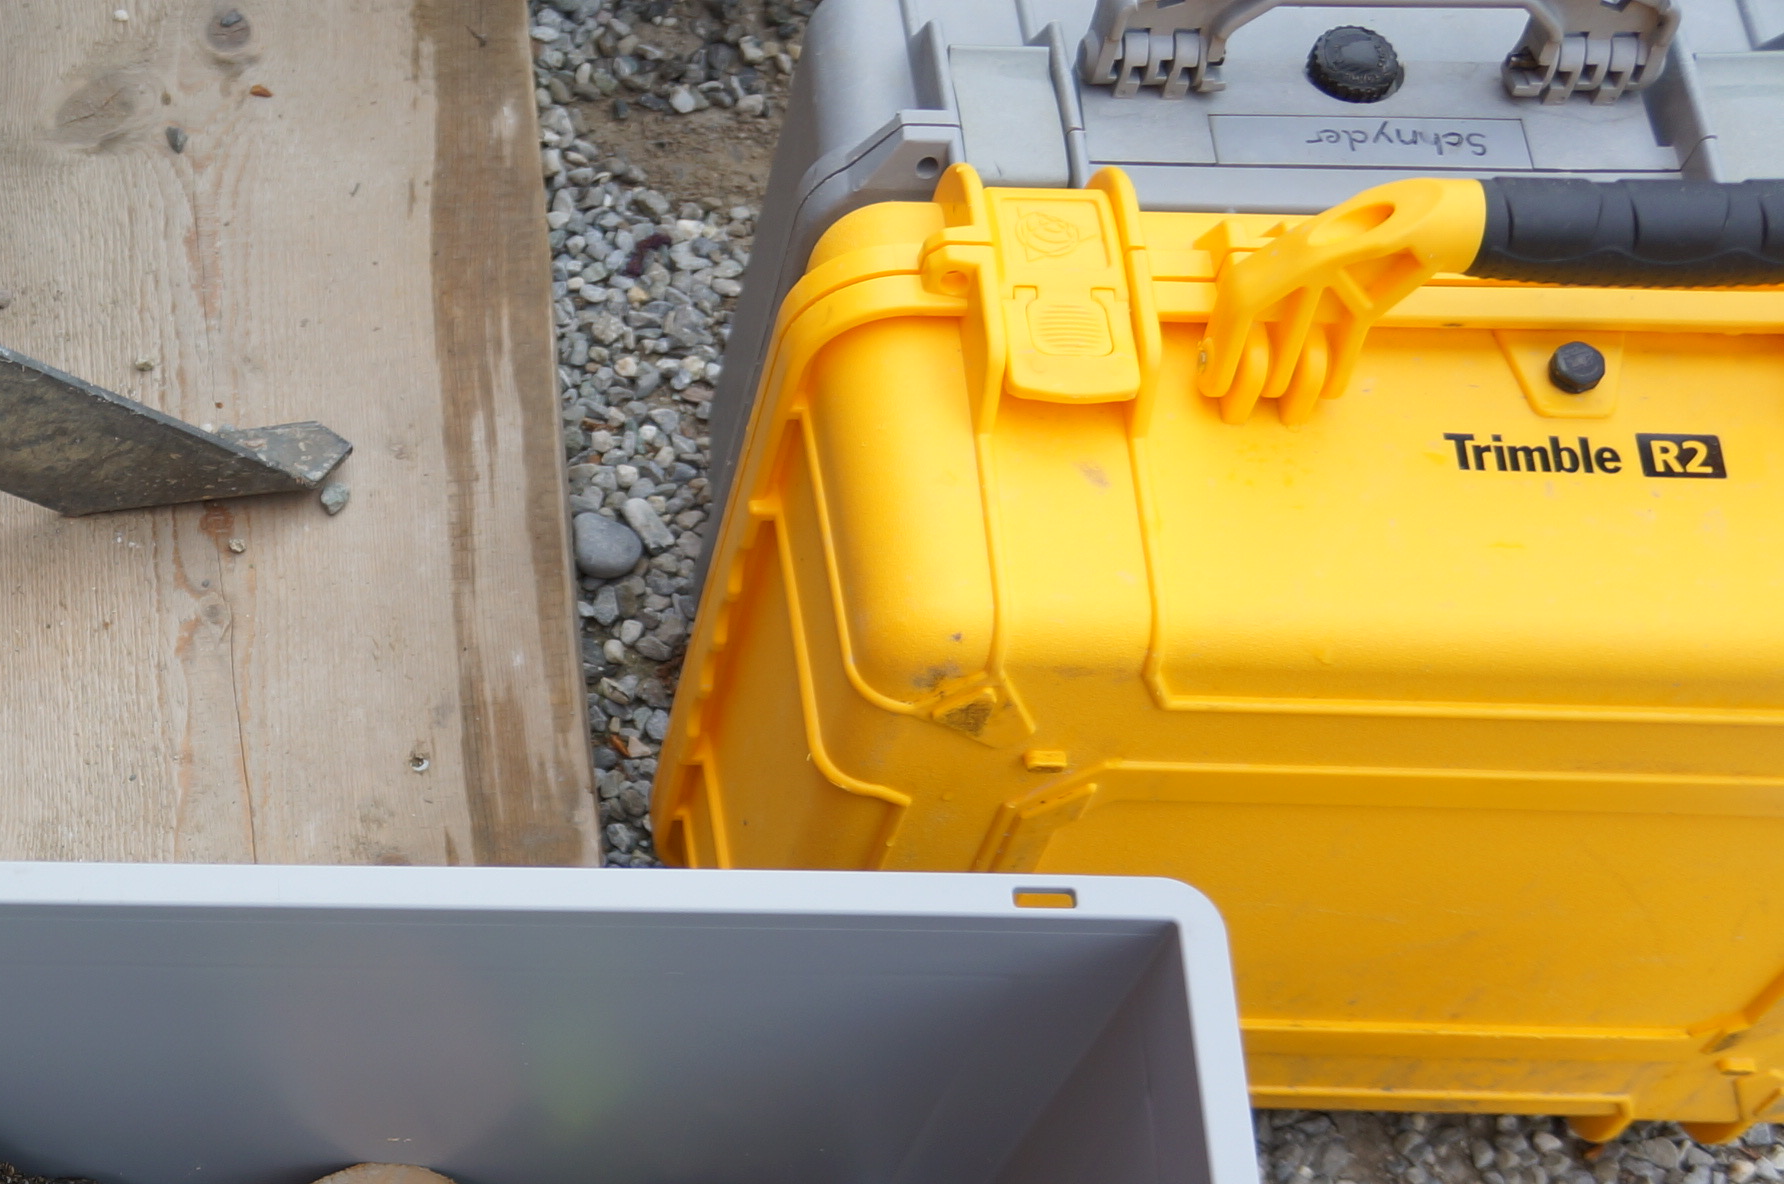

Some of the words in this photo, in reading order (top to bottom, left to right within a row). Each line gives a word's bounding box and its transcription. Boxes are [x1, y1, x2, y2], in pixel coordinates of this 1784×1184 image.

[1304, 120, 1487, 156] Schnyder
[1443, 433, 1622, 474] Trimble
[1649, 439, 1714, 474] R2
